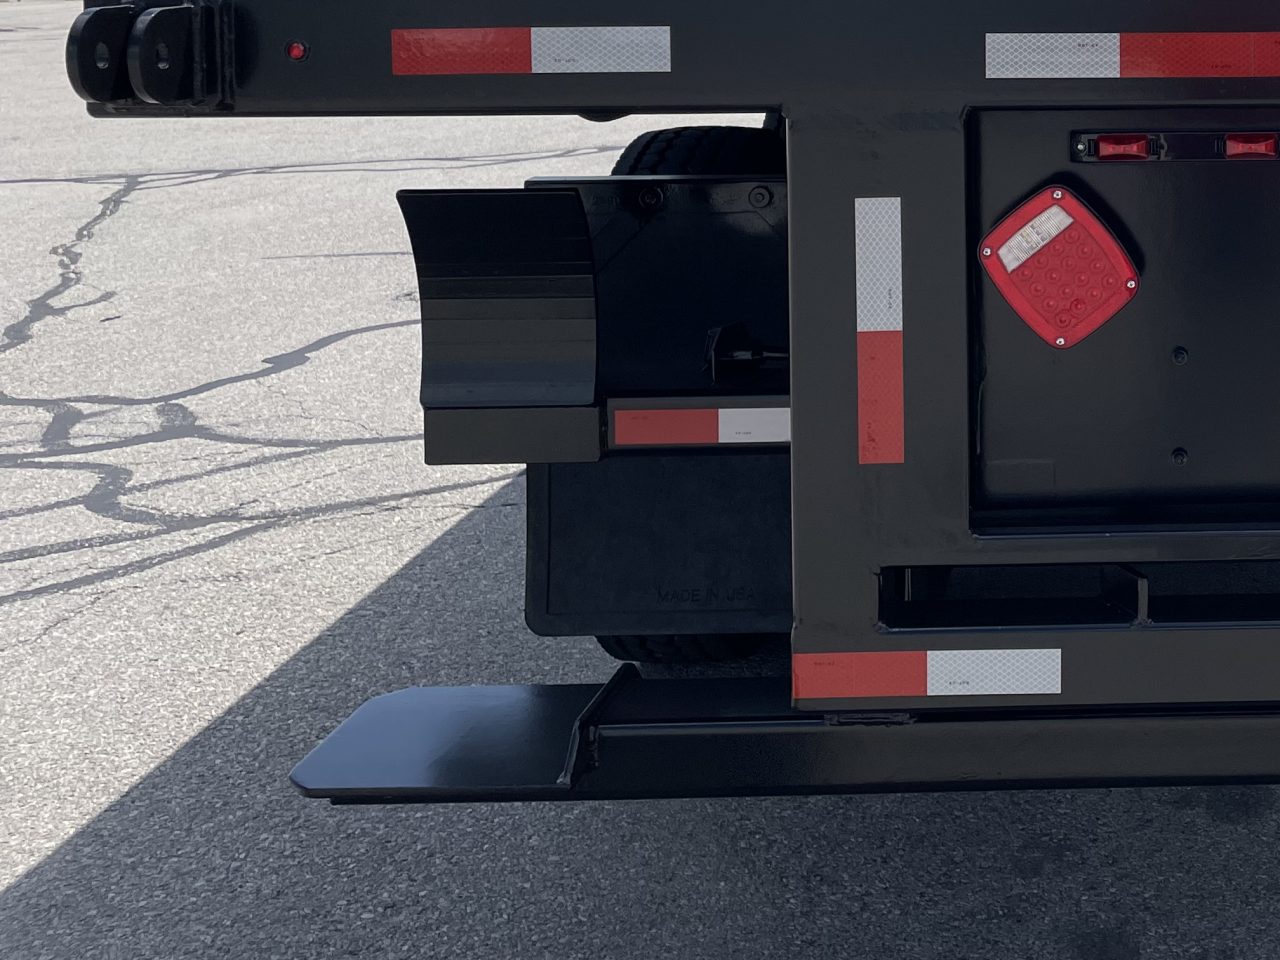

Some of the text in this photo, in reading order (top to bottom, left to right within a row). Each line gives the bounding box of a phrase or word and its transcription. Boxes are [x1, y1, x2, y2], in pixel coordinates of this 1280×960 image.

[656, 586, 757, 603] MADE IN USA
